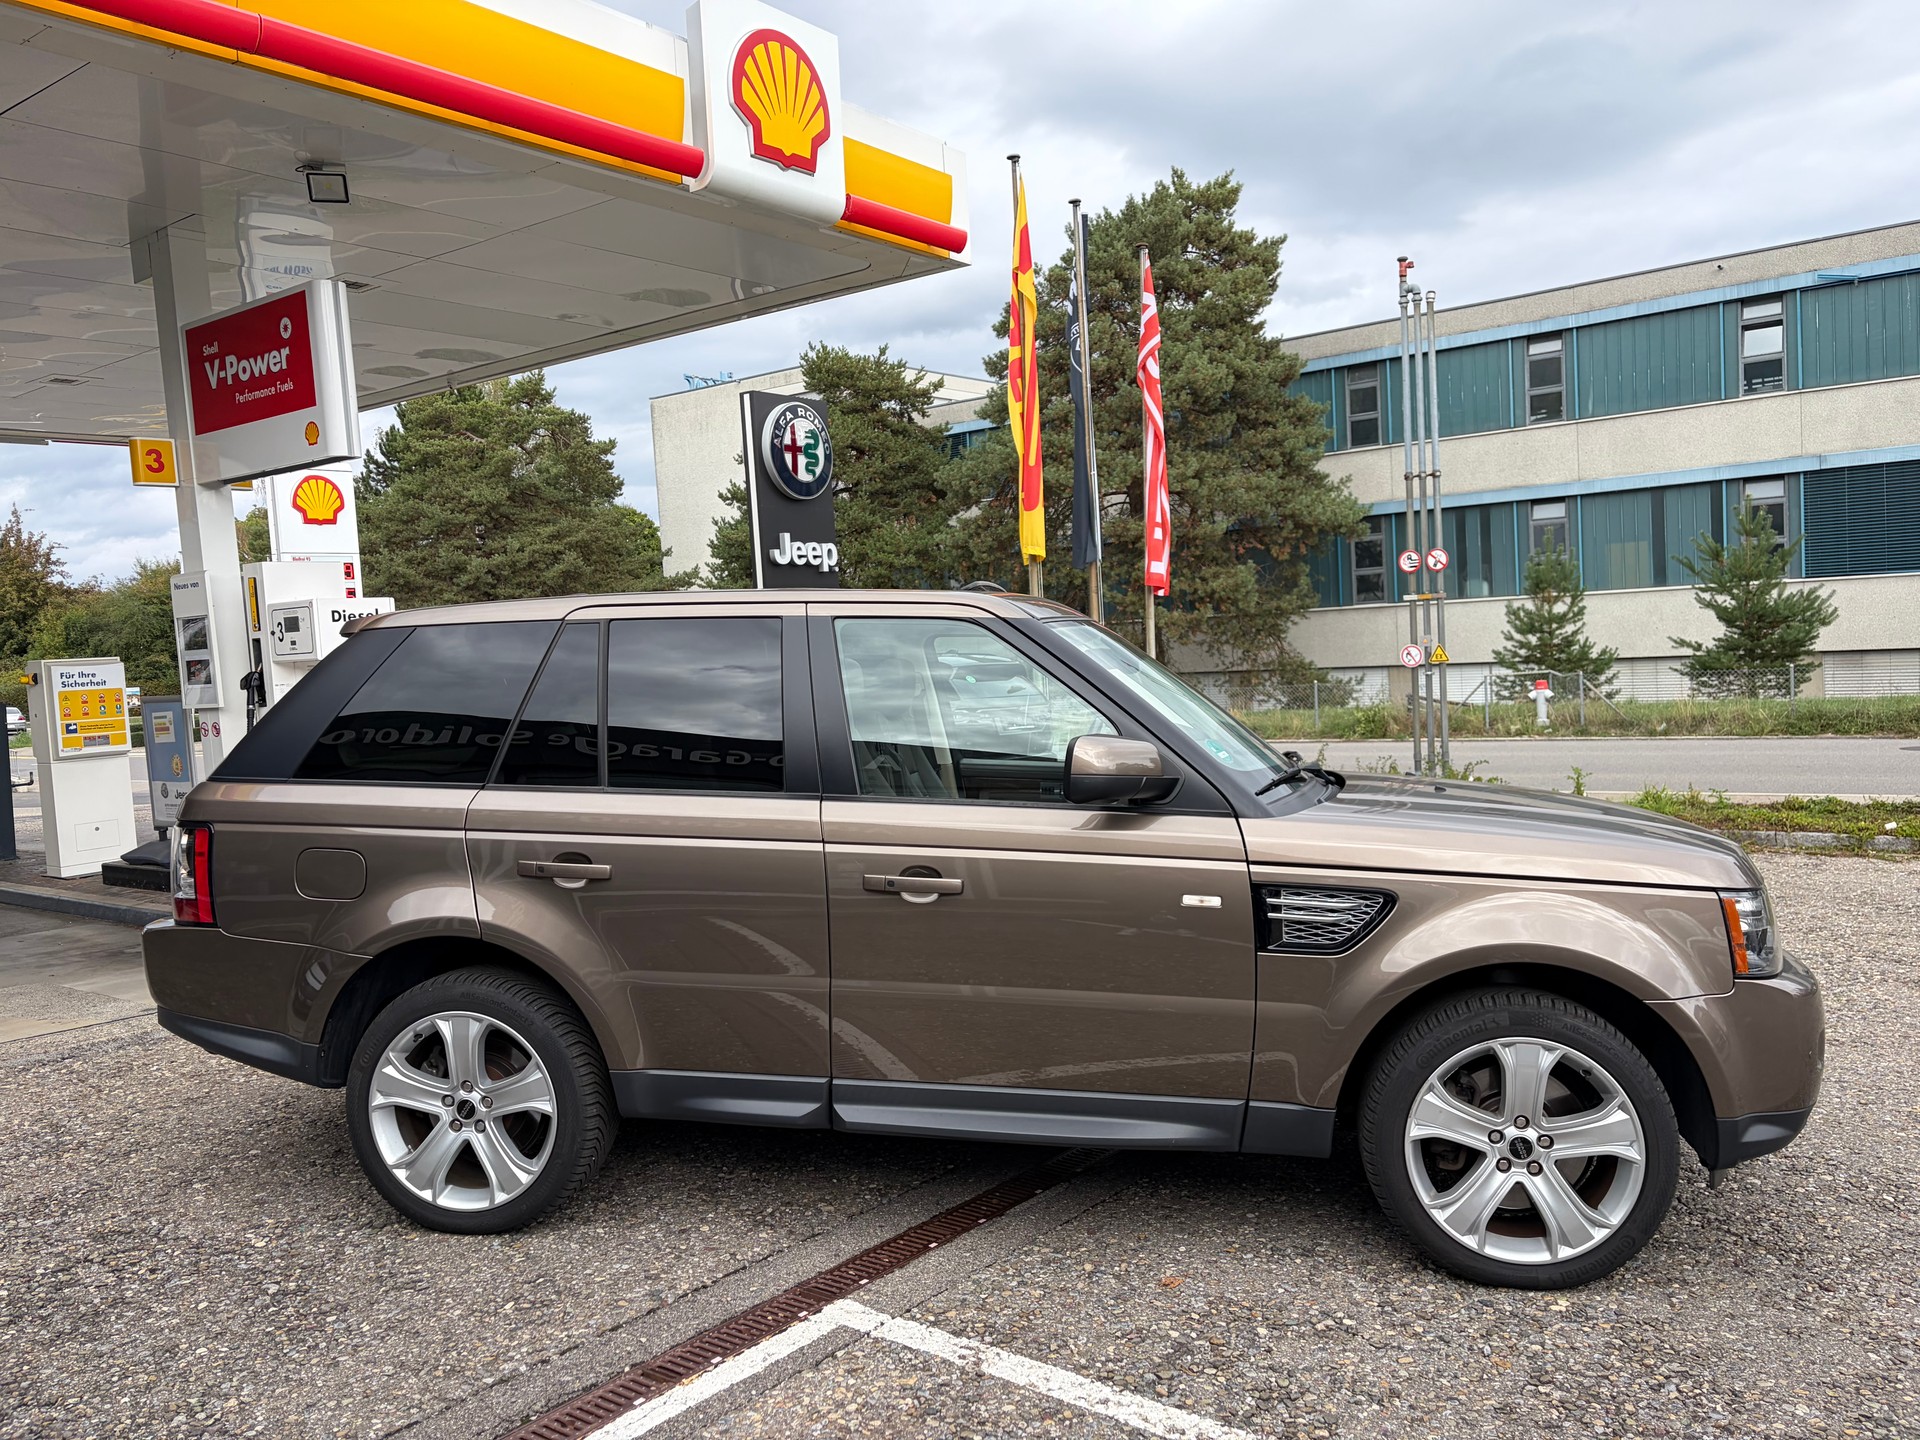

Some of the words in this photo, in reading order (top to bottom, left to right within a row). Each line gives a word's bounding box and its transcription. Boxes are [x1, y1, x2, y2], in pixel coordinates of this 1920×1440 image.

[202, 341, 219, 357] Shell
[204, 345, 290, 390] V-Power
[235, 384, 276, 404] Performance
[276, 378, 294, 394] Fuels
[773, 410, 795, 449] ALFA
[797, 406, 830, 456] ROMEO
[144, 448, 165, 474] 3
[769, 532, 838, 573] Jeep
[173, 581, 189, 591] Neues
[190, 581, 200, 589] von
[276, 621, 285, 643] 3
[59, 671, 76, 680] Für
[78, 670, 97, 679] Ihre
[60, 678, 107, 689] Sicherheit
[1415, 1020, 1489, 1069] Continental
